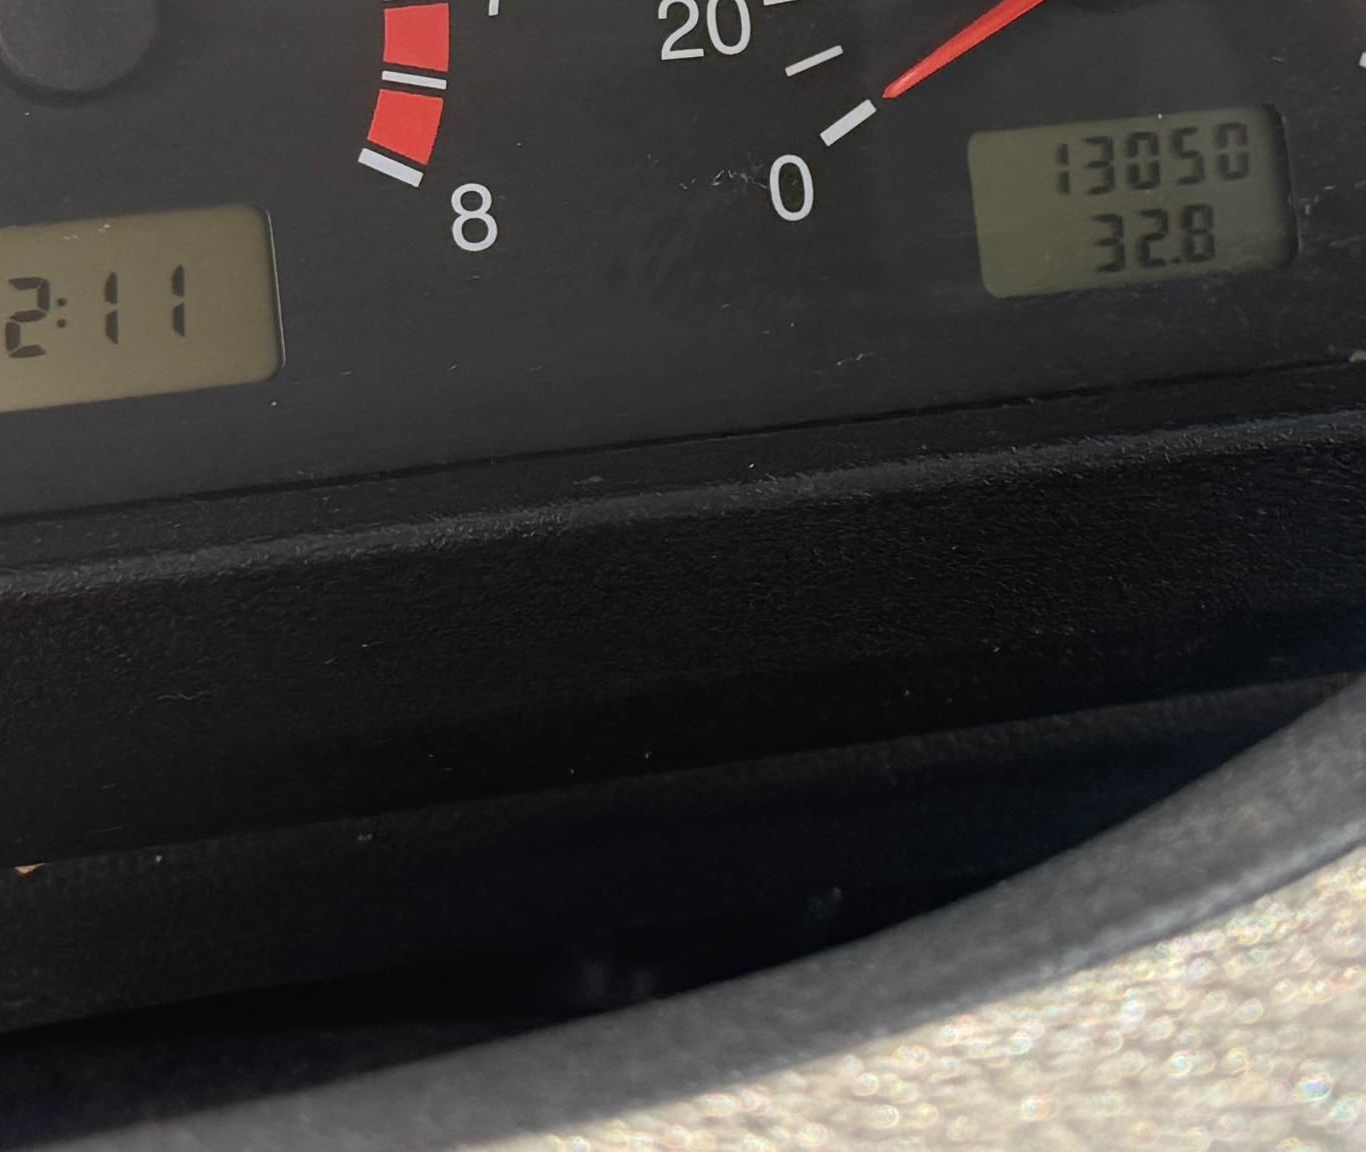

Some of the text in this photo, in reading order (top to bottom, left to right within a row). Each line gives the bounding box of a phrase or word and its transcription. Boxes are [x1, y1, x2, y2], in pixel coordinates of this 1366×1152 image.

[767, 152, 816, 222] 0
[1055, 122, 1250, 195] 13050
[451, 183, 498, 252] 8
[1092, 204, 1215, 274] 32.8
